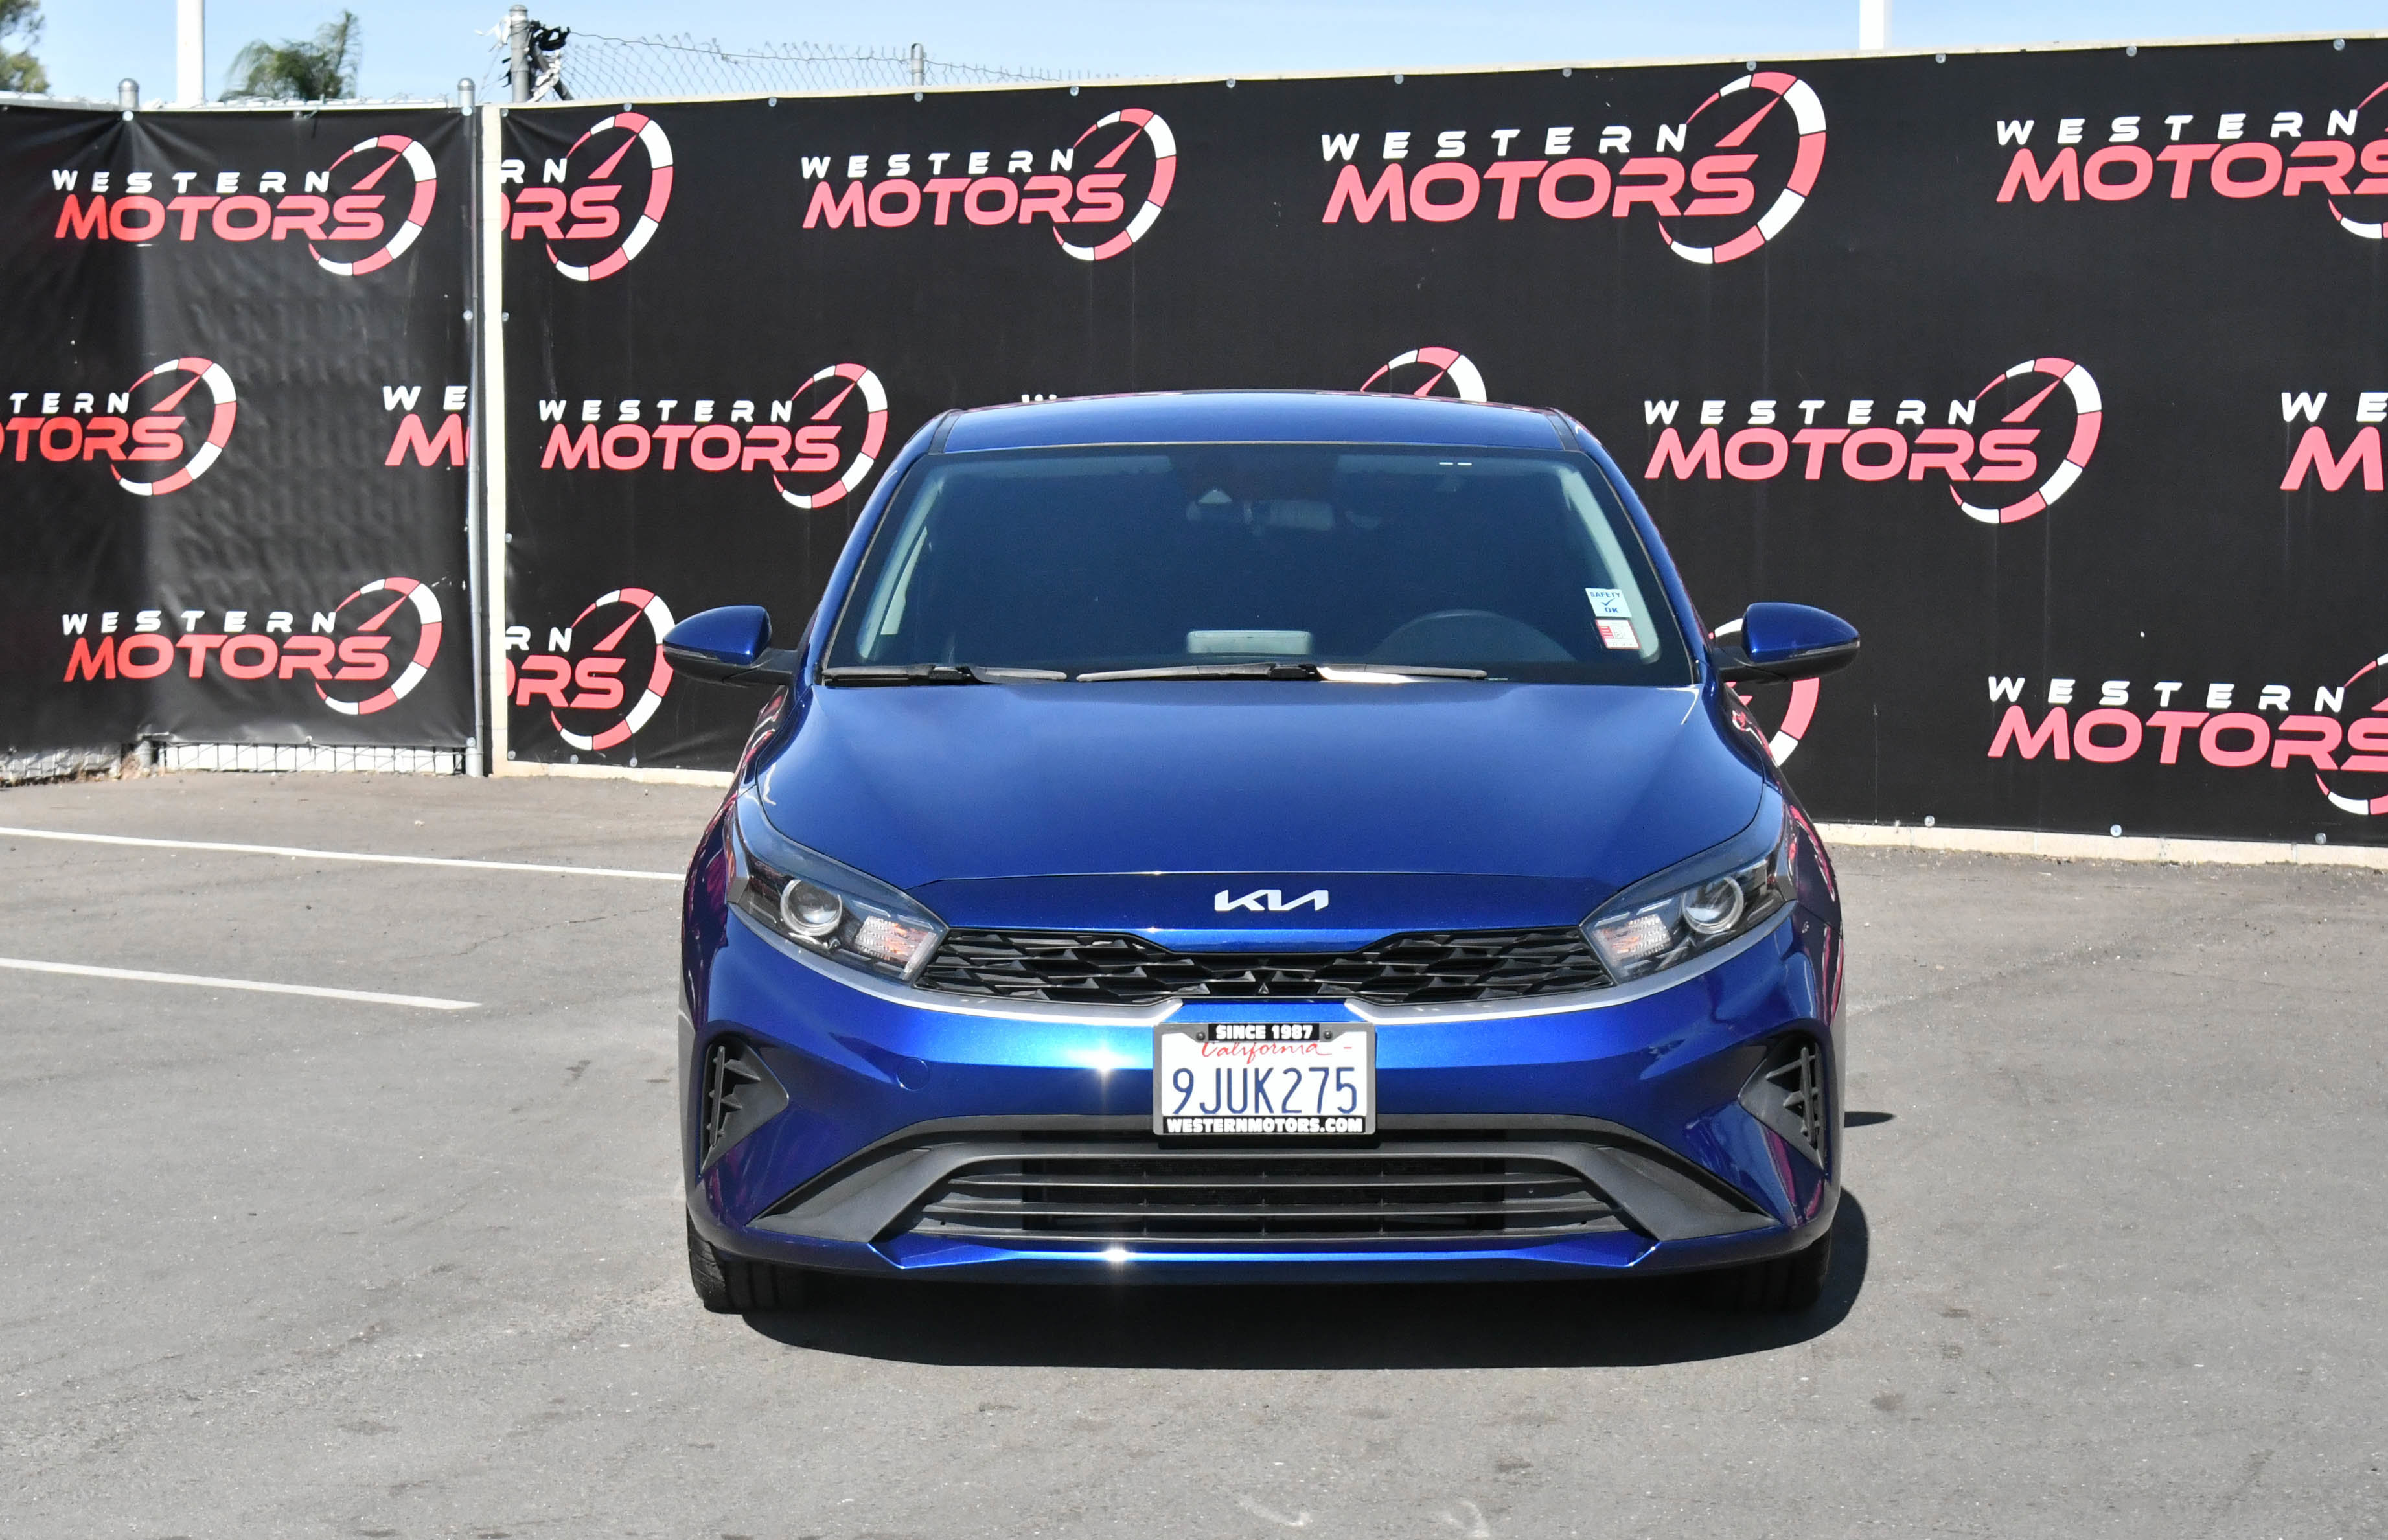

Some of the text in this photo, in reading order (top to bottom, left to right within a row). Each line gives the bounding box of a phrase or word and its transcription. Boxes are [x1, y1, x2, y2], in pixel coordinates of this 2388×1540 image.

[1321, 123, 1687, 161] WESTERN
[1996, 109, 2358, 145] WESTERN
[52, 170, 330, 192] WESTERN
[801, 148, 1074, 179] WESTERN
[803, 173, 1127, 229] MOTORS
[1322, 154, 1759, 224] MOTORS
[54, 194, 386, 242] MOTORS
[501, 185, 622, 240] RS
[9, 392, 130, 414] TERN
[539, 399, 793, 422] WESTERN
[1644, 400, 1977, 425] WESTERN
[0, 416, 187, 462] TORS
[541, 424, 842, 472] MOTORS
[1644, 427, 2041, 481] MOTORS
[62, 610, 337, 635] WESTERN
[64, 634, 391, 682] MOTORS
[506, 654, 626, 709] RS
[1988, 676, 2345, 713] WESTERN
[1214, 889, 1329, 911] KIA
[1215, 1024, 1313, 1040] SINCE 1987
[1202, 1042, 1333, 1064] California
[1173, 1067, 1357, 1114] 9JUK275
[1167, 1118, 1363, 1133] WESTERNMOTORS.COM
